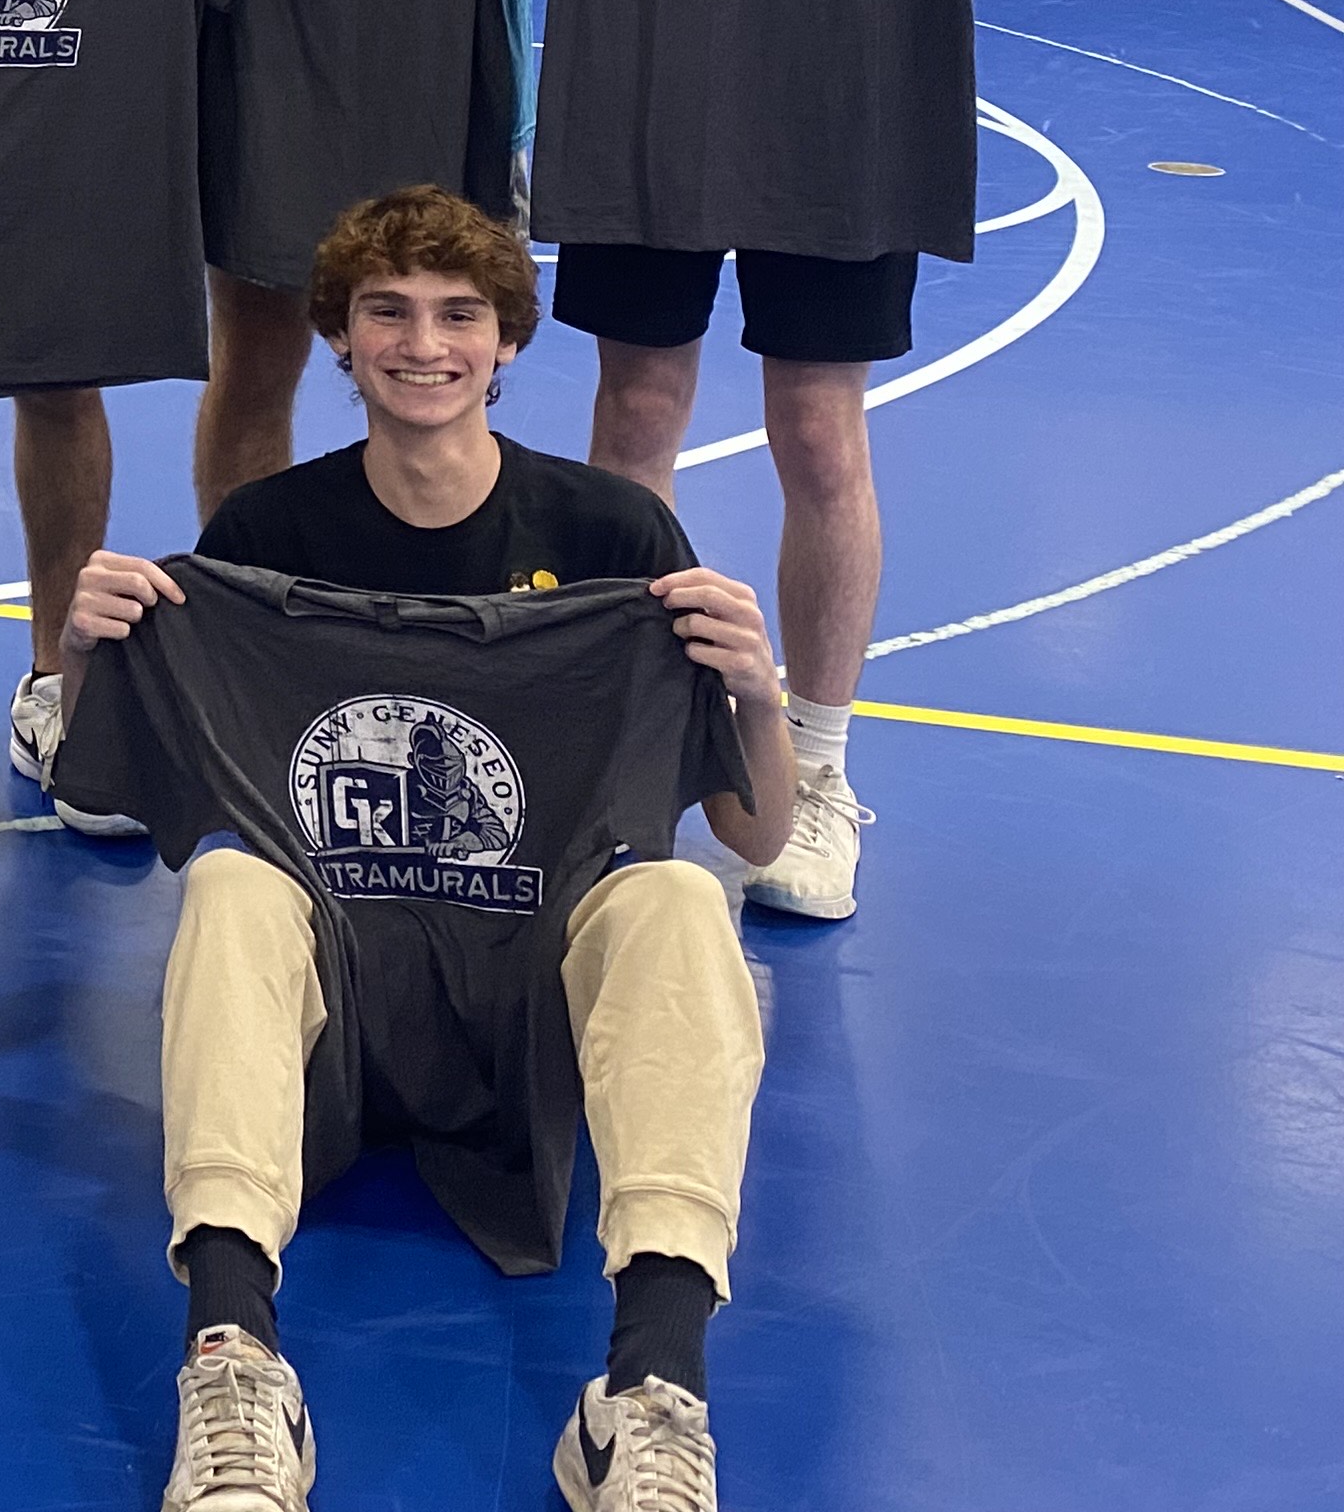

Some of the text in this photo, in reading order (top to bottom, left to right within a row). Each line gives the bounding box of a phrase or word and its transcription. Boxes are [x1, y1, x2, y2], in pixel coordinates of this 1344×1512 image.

[298, 705, 513, 800] SUNY GENESEO
[319, 861, 535, 904] TRAMURALS
